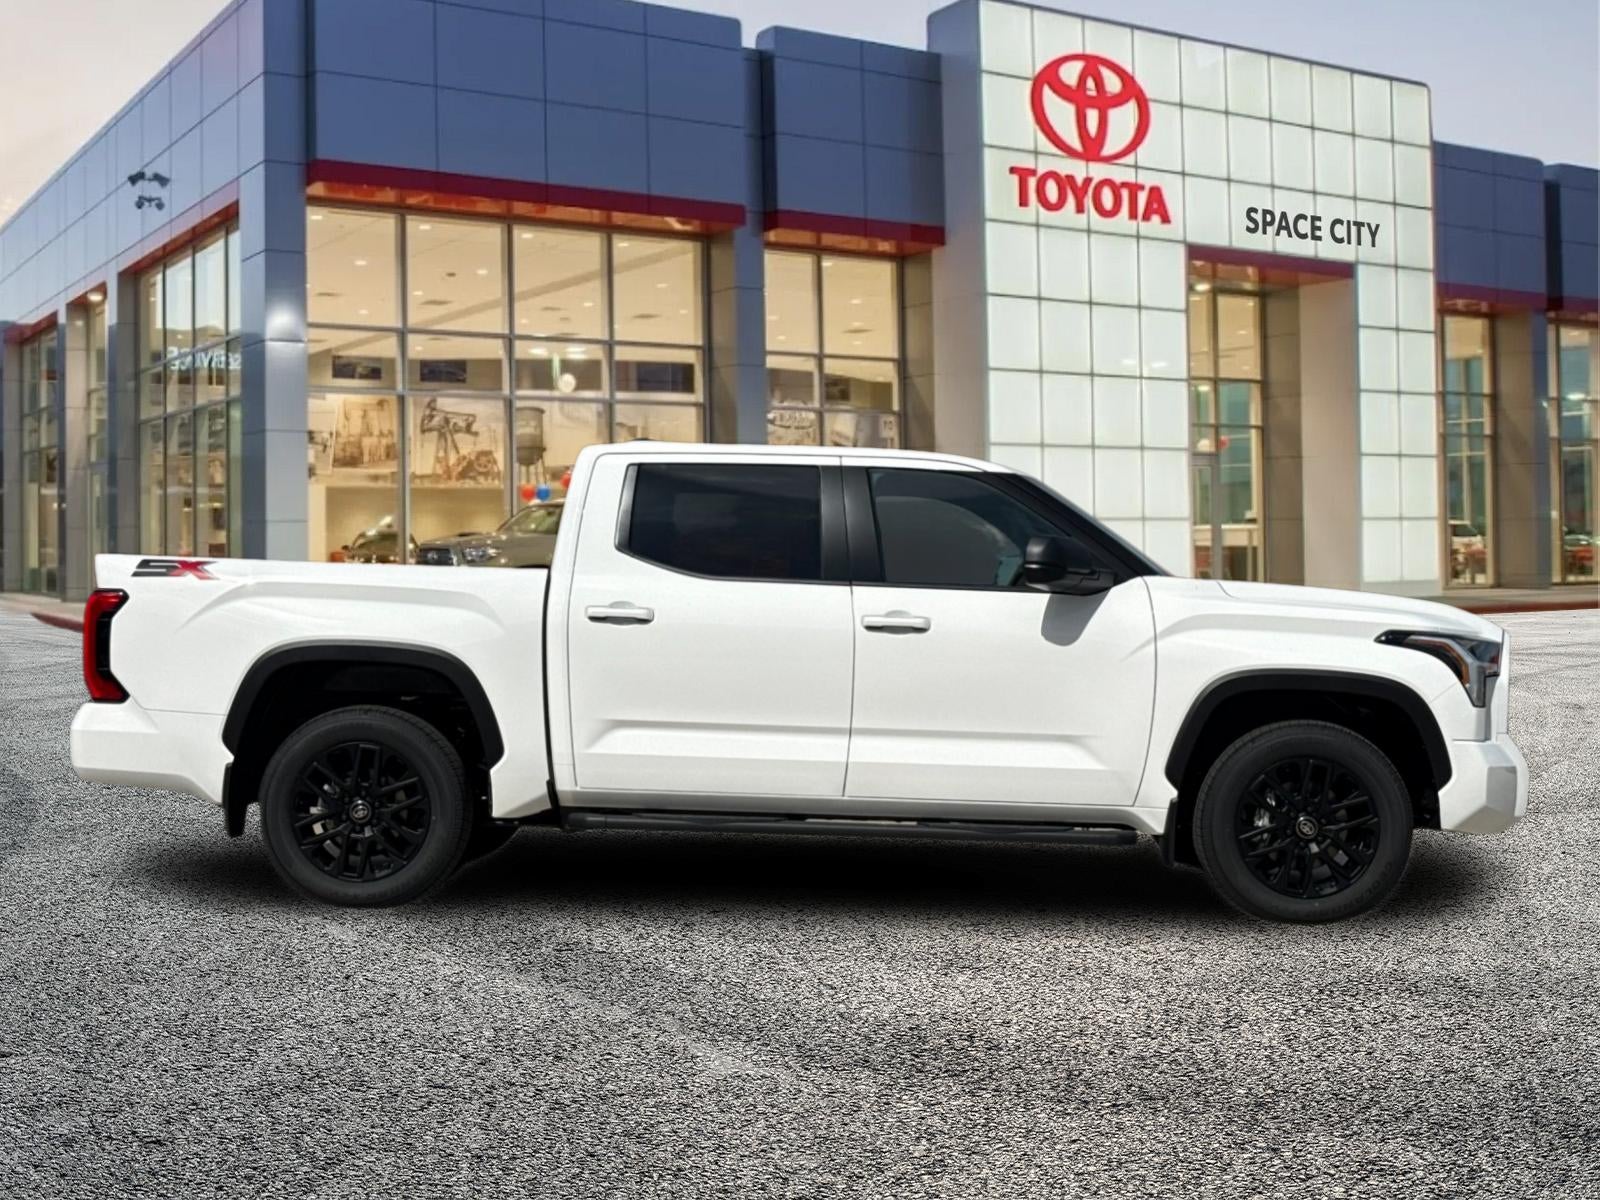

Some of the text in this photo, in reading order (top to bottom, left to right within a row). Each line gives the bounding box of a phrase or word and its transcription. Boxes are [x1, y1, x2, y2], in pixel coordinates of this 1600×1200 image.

[1009, 166, 1171, 225] TOYOTA
[1245, 206, 1381, 248] SPACE CITY
[131, 558, 221, 581] SX
